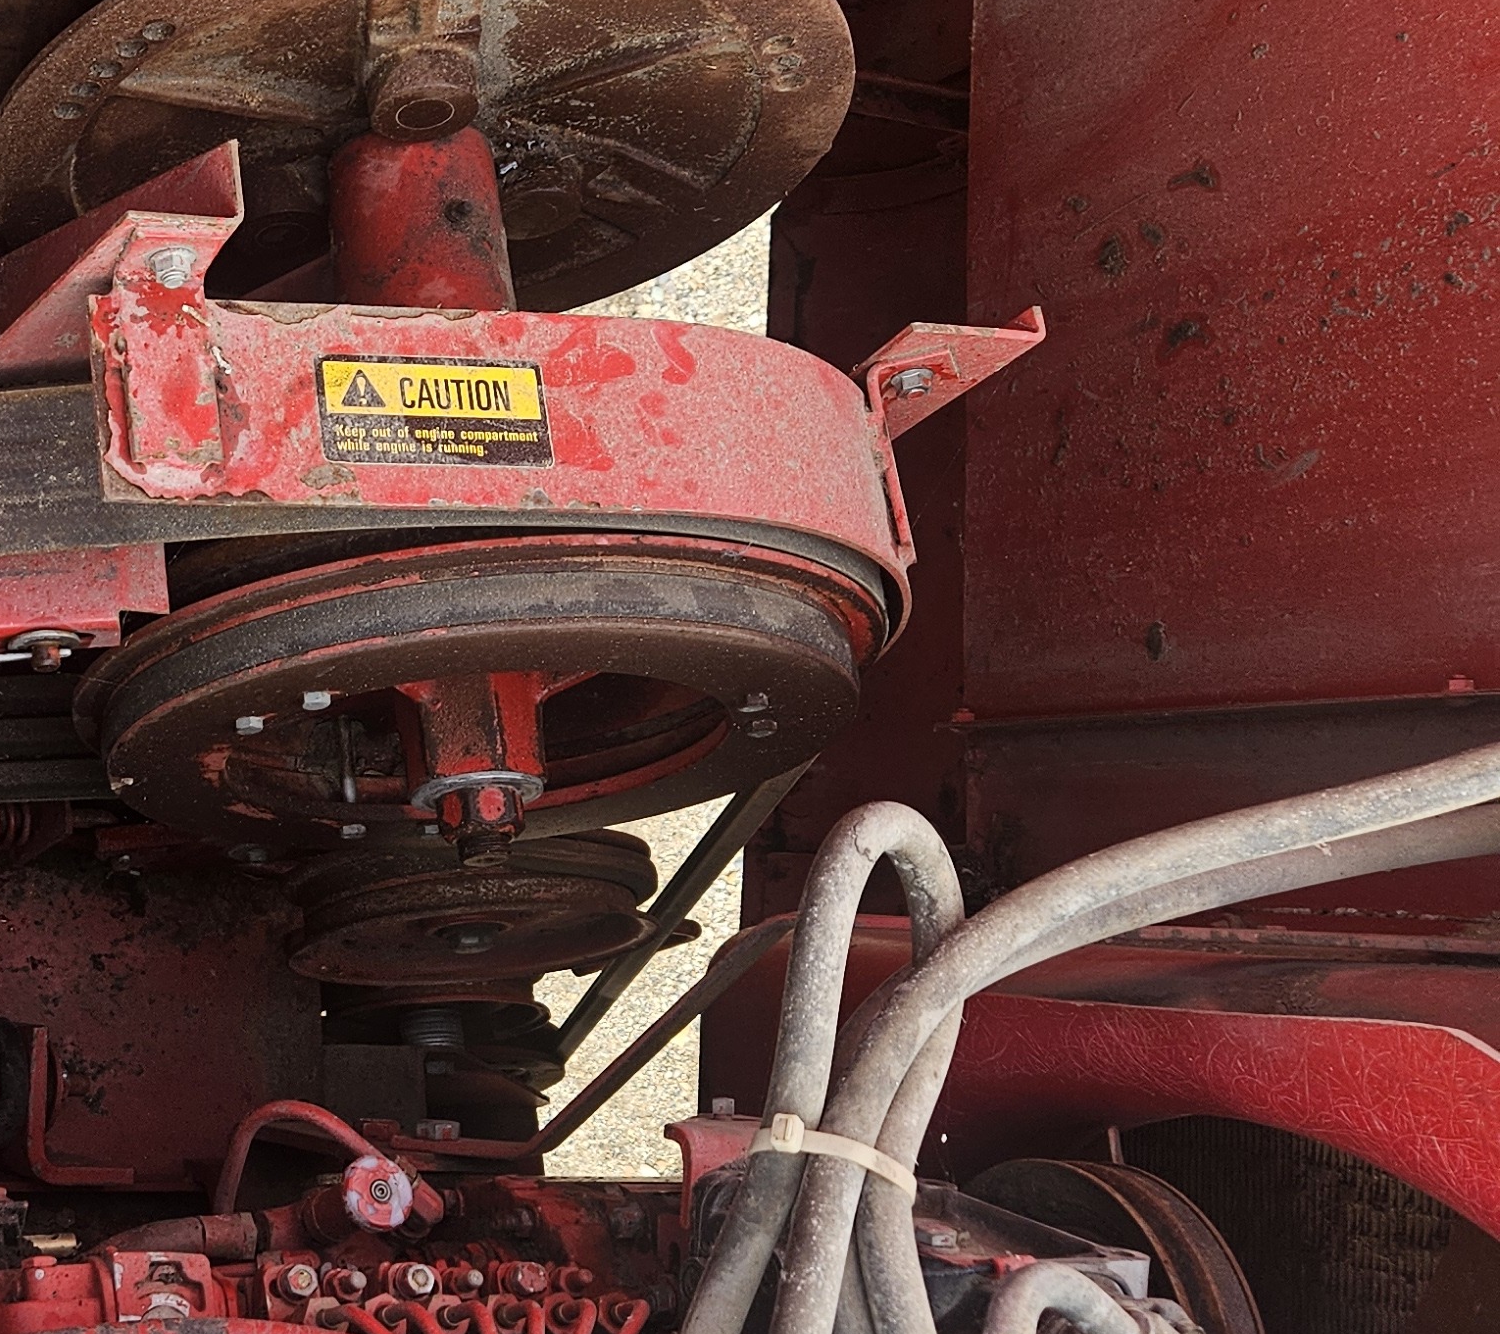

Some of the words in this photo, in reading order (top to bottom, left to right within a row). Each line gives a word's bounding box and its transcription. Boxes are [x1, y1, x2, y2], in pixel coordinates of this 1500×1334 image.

[400, 376, 511, 411] CAUTION
[334, 424, 366, 440] Keep
[372, 427, 391, 438] out
[398, 426, 409, 438] of
[415, 427, 455, 442] engine
[460, 430, 538, 442] compartment
[337, 439, 370, 451] while
[376, 440, 416, 454] engine
[421, 440, 432, 453] is
[438, 441, 488, 456] running.
